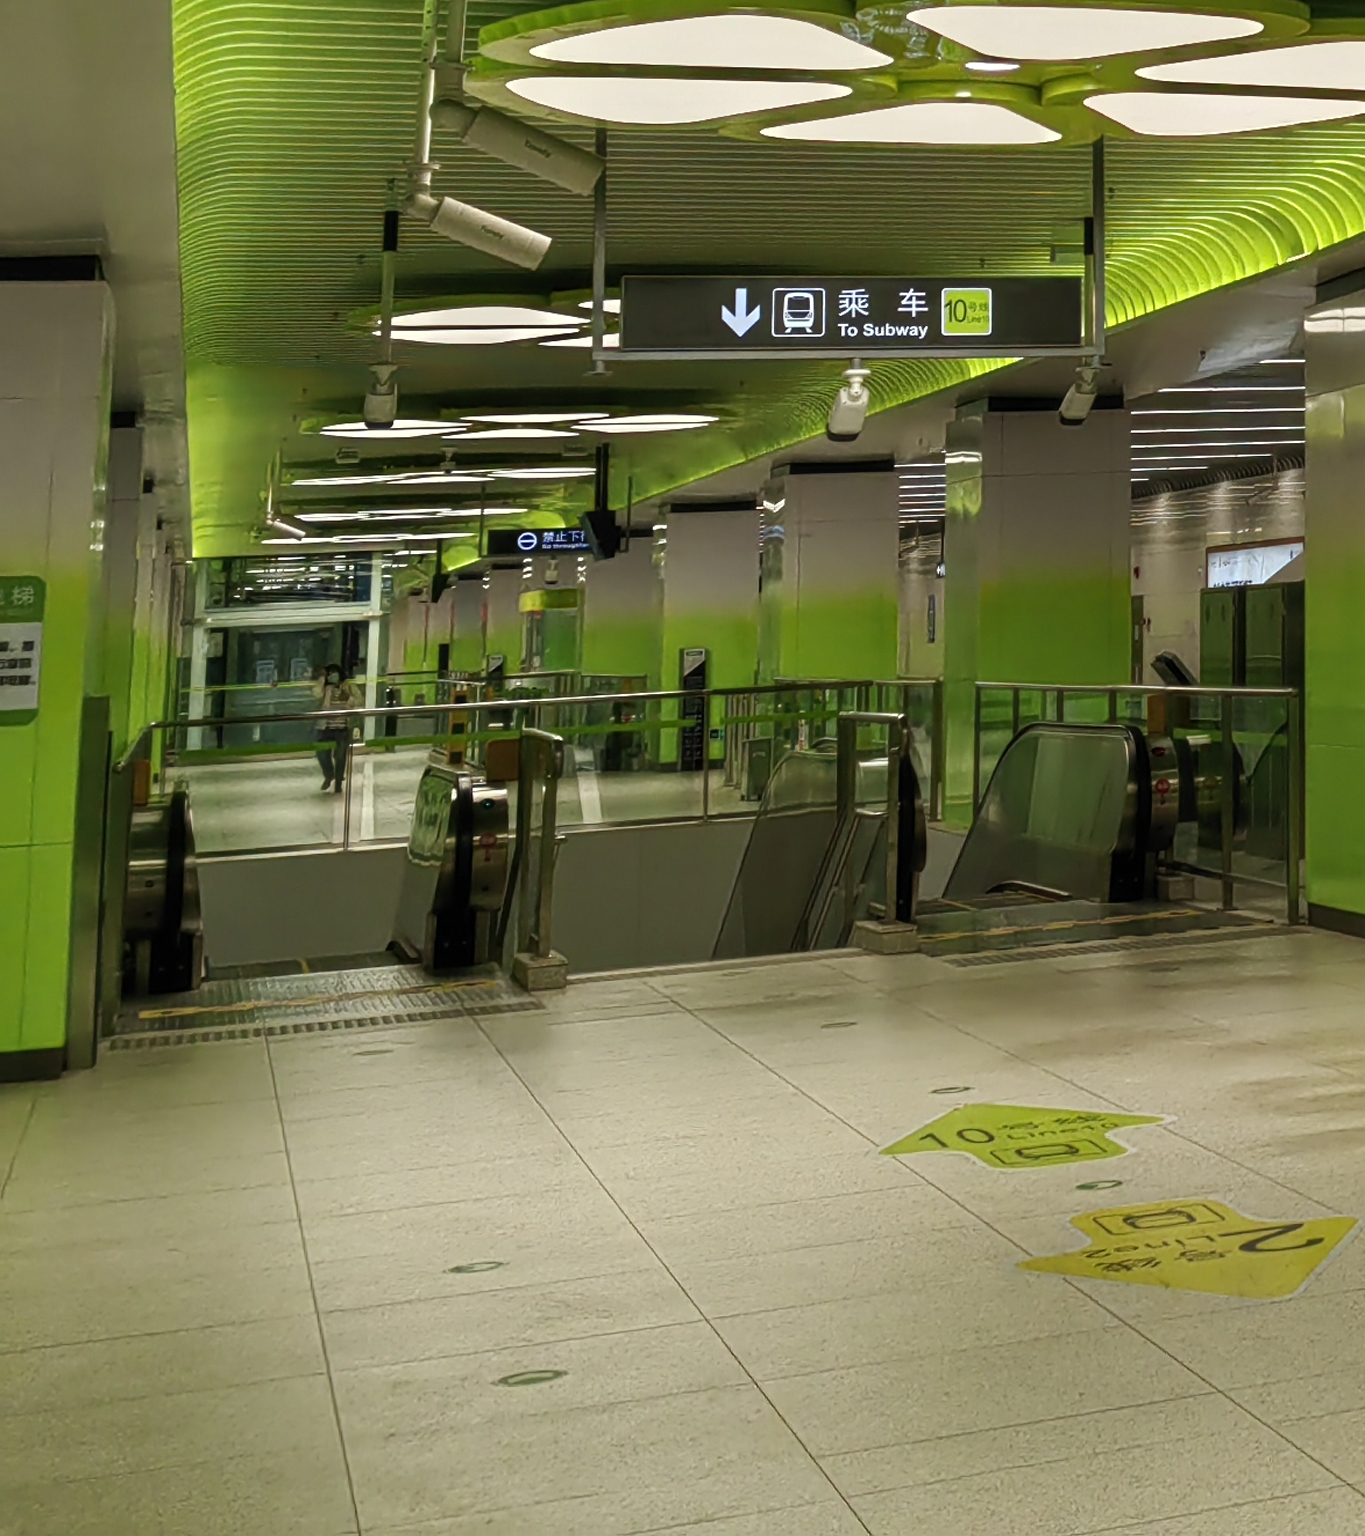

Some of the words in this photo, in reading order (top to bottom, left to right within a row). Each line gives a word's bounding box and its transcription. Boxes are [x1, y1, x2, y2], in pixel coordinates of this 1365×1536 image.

[838, 288, 929, 318] 乘车
[837, 323, 858, 337] To
[863, 322, 929, 339] Subway
[919, 1128, 995, 1148] 10
[1218, 1223, 1325, 1252] 2
